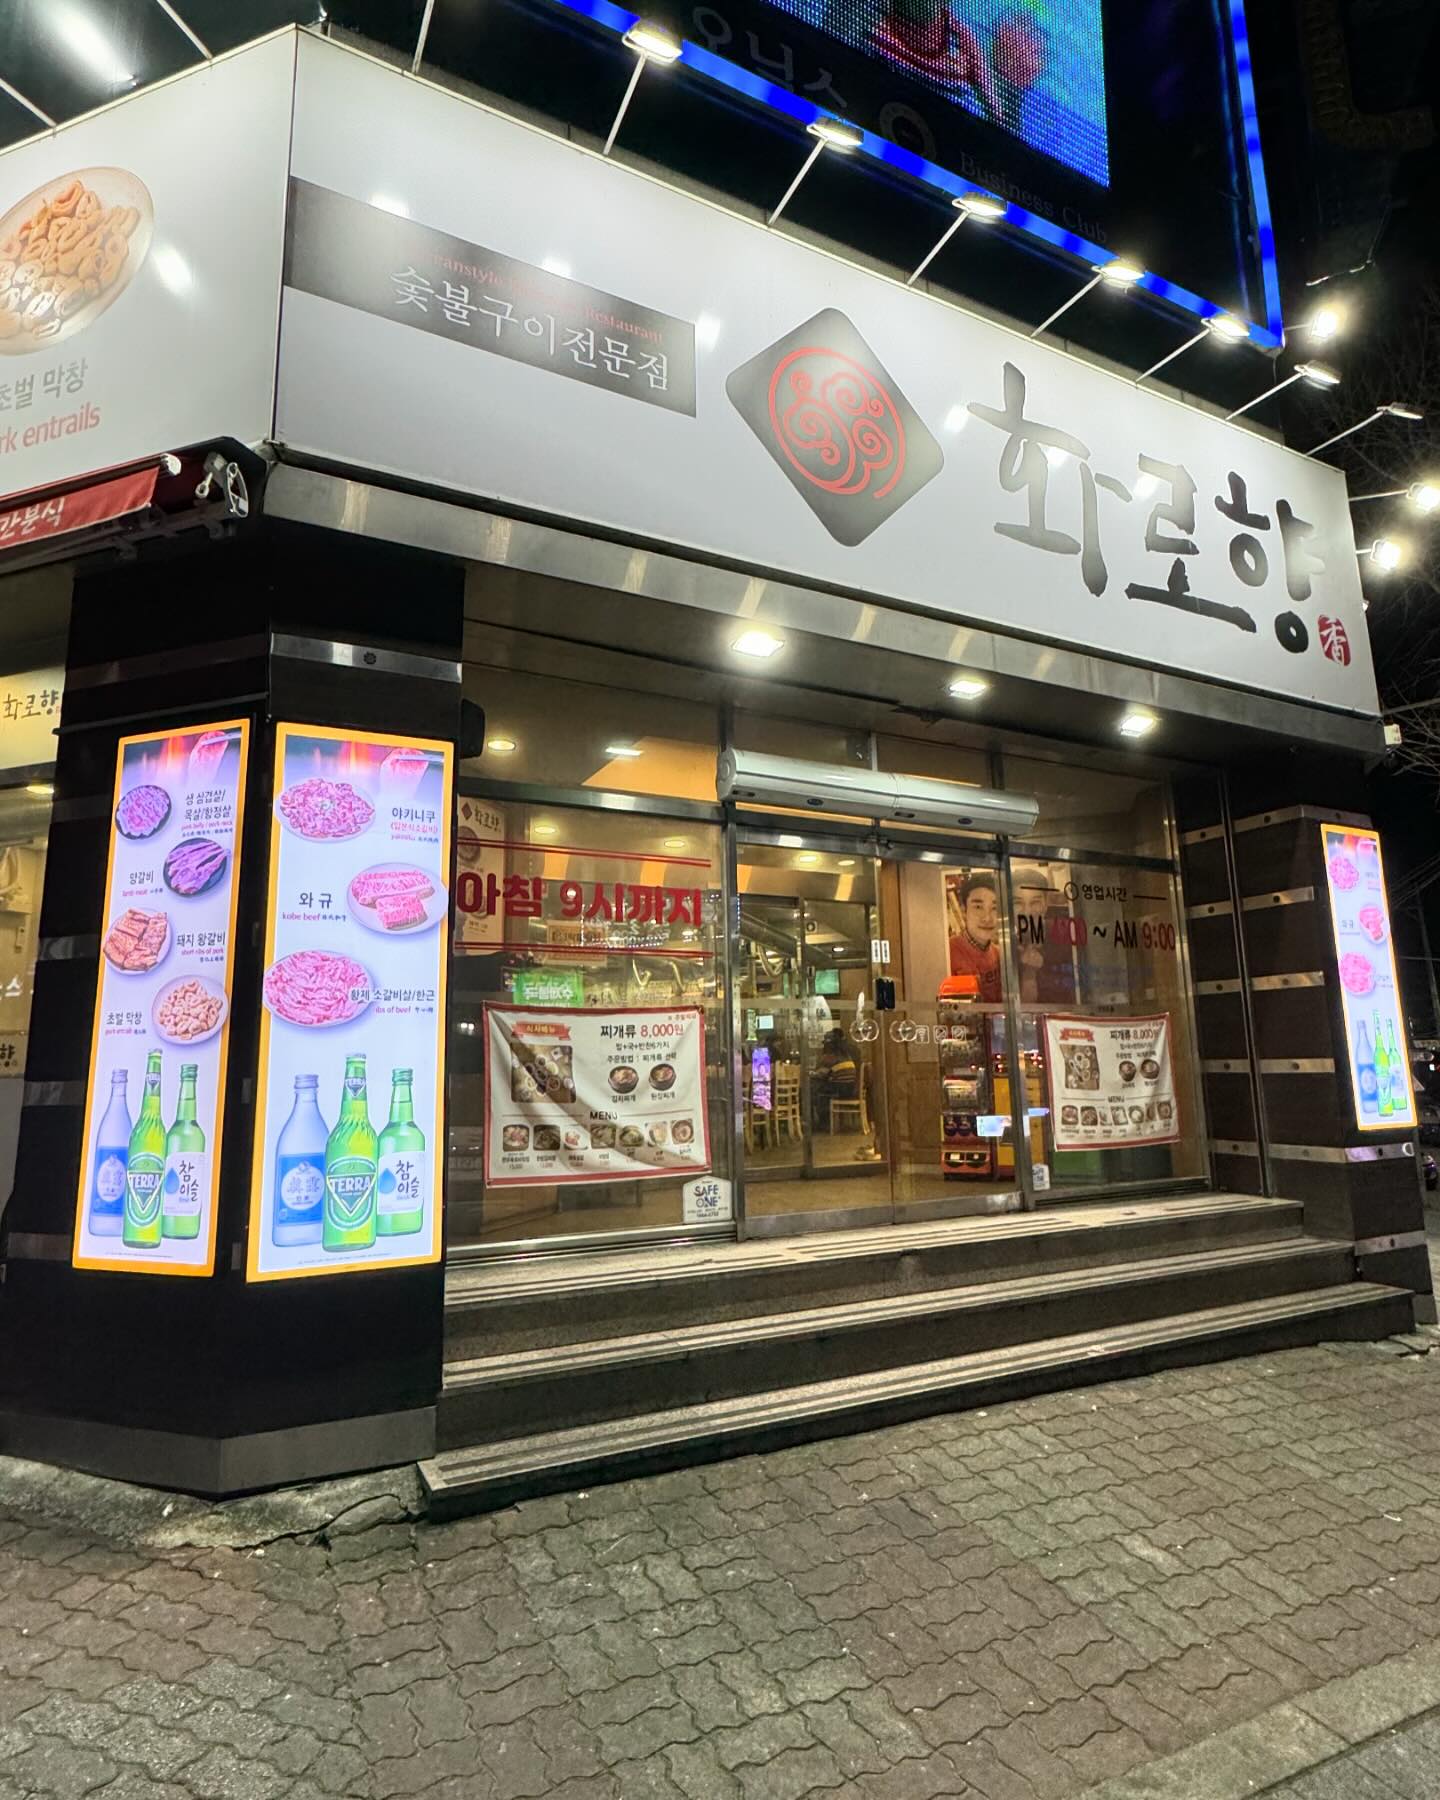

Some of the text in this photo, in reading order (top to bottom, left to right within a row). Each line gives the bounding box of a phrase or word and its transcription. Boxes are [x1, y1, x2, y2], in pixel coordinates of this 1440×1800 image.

[960, 150, 1107, 243] Business Club
[390, 266, 669, 391] 숯불구이전문점
[43, 358, 88, 399] 막창
[22, 402, 101, 447] entrails
[967, 361, 1325, 654] 화로향
[3, 690, 59, 720] 화로향
[392, 807, 435, 823] 야키니쿠
[130, 870, 154, 885] 양갈비
[299, 892, 333, 909] 와 규
[457, 872, 702, 927] 아침 9시까지
[1081, 883, 1127, 902] 영업시간
[282, 911, 301, 920] kobe
[304, 911, 320, 921] beef
[177, 931, 225, 947] 돼지 왕갈비
[1017, 914, 1045, 945] PM
[1113, 920, 1138, 949] AM
[1142, 922, 1176, 951] 9:00
[600, 1024, 637, 1039] 찌개류
[589, 1111, 618, 1121] MENU
[130, 1174, 160, 1188] TERRA
[330, 1176, 372, 1192] TERRA
[694, 1184, 719, 1197] SAFE
[696, 1196, 719, 1208] ONE
